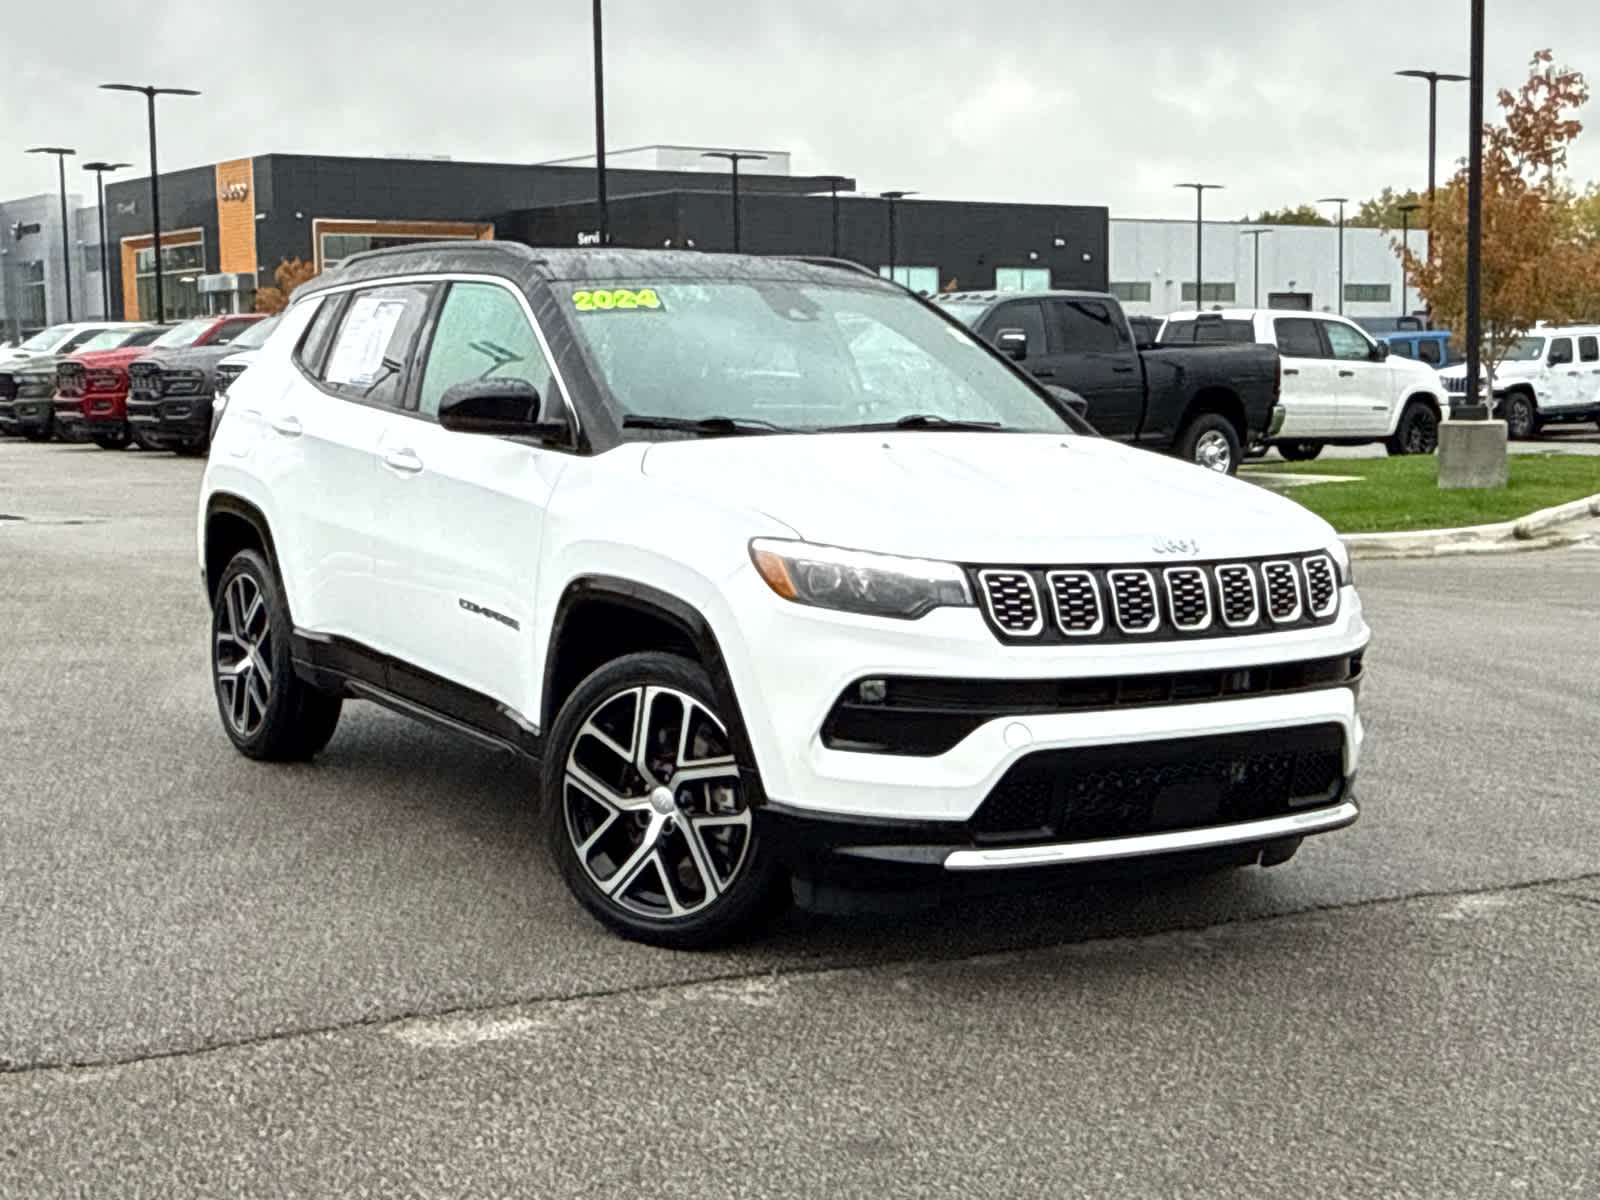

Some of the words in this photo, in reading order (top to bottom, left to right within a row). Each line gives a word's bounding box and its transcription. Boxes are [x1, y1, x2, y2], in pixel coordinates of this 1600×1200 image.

[577, 231, 610, 246] Servi
[572, 289, 661, 311] 2024
[1151, 535, 1200, 557] Jeep
